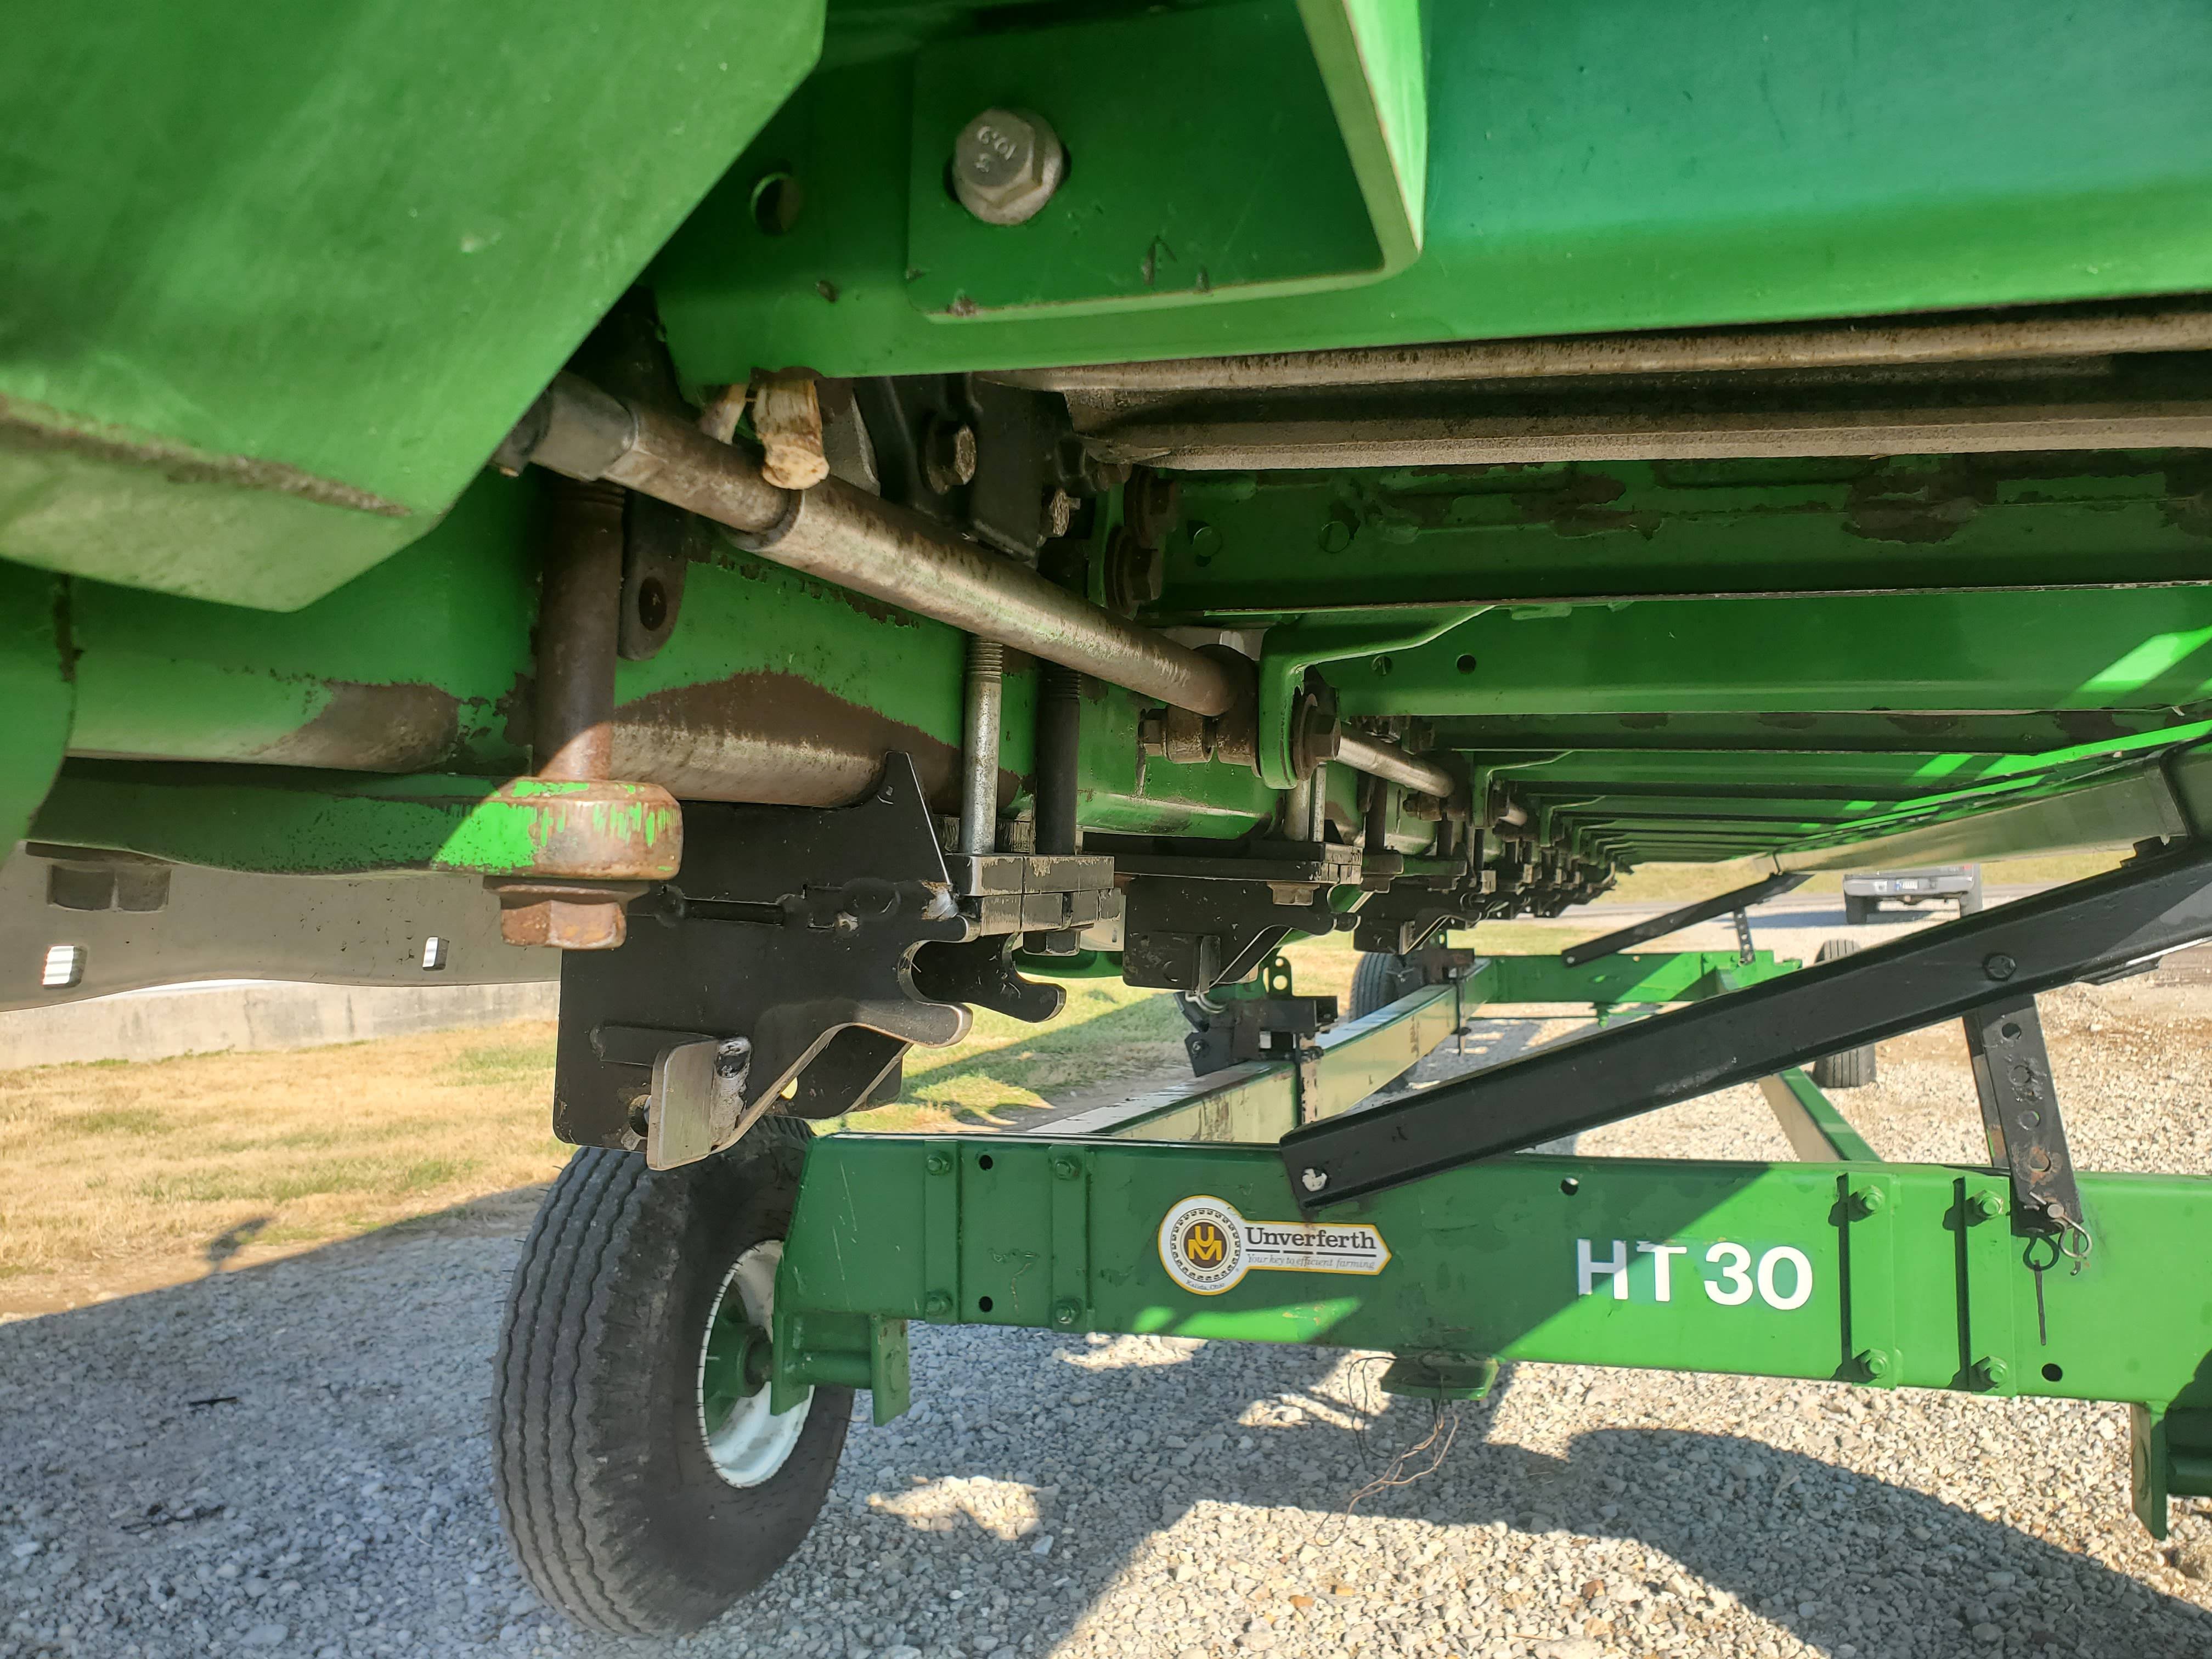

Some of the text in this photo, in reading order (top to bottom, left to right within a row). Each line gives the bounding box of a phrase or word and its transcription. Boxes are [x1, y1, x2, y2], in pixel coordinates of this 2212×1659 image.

[1244, 1227, 1376, 1249] Unverferth
[1246, 1253, 1375, 1269] Your key to efficient farming
[1577, 1238, 1813, 1311] HT 30
